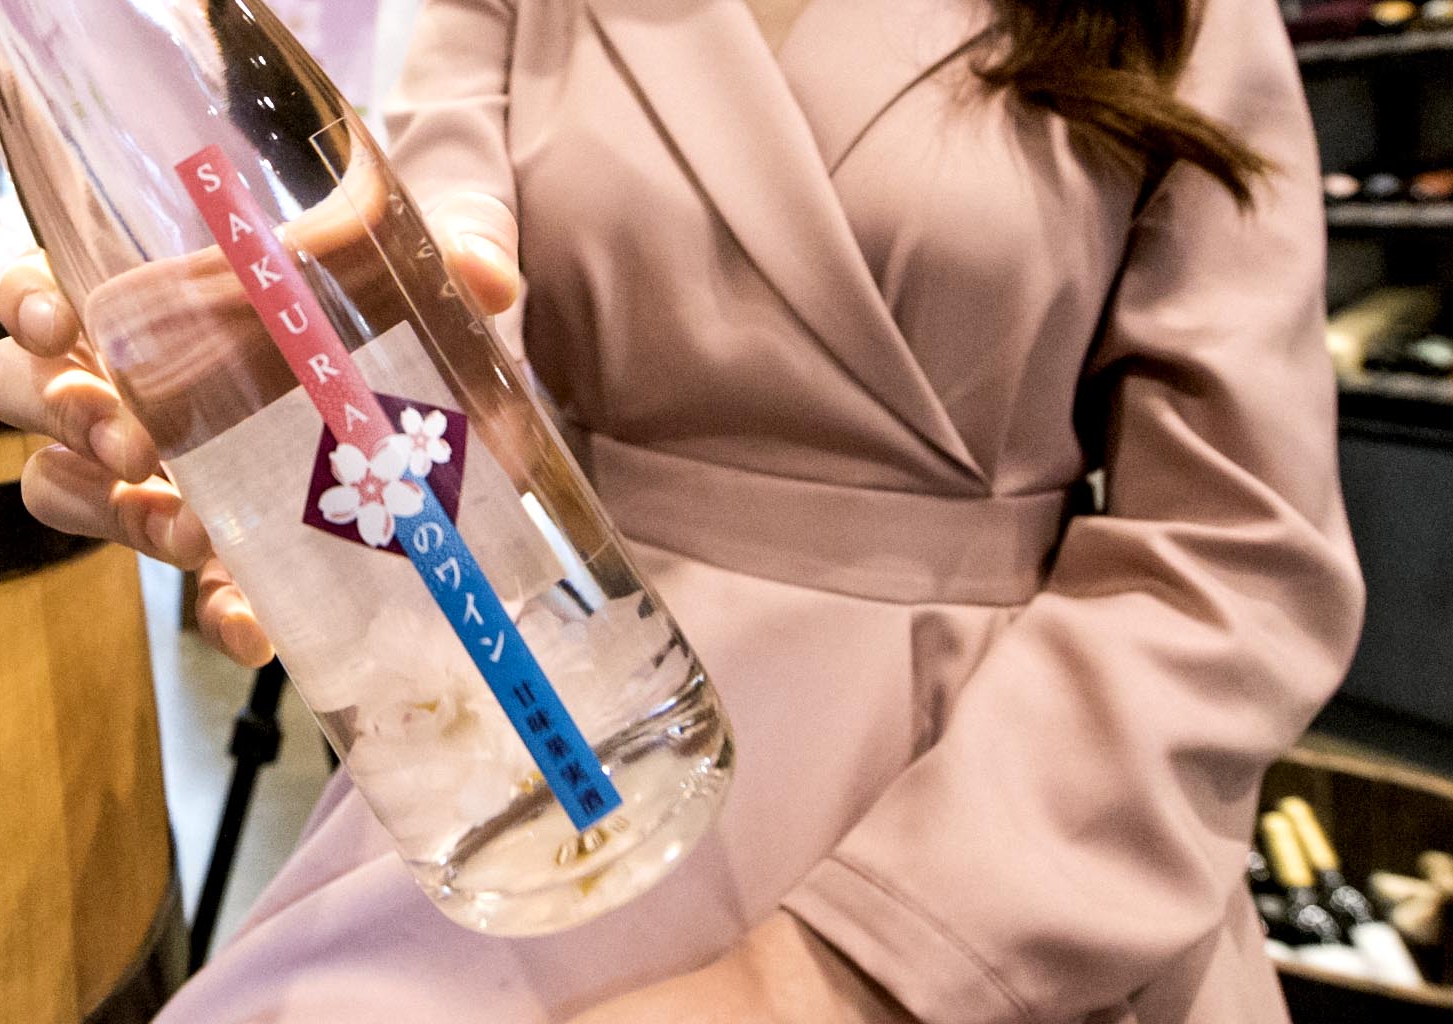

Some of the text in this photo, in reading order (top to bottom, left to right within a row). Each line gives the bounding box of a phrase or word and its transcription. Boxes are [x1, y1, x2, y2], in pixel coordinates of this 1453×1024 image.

[196, 162, 369, 433] SAKURA
[413, 522, 505, 663] のワイン
